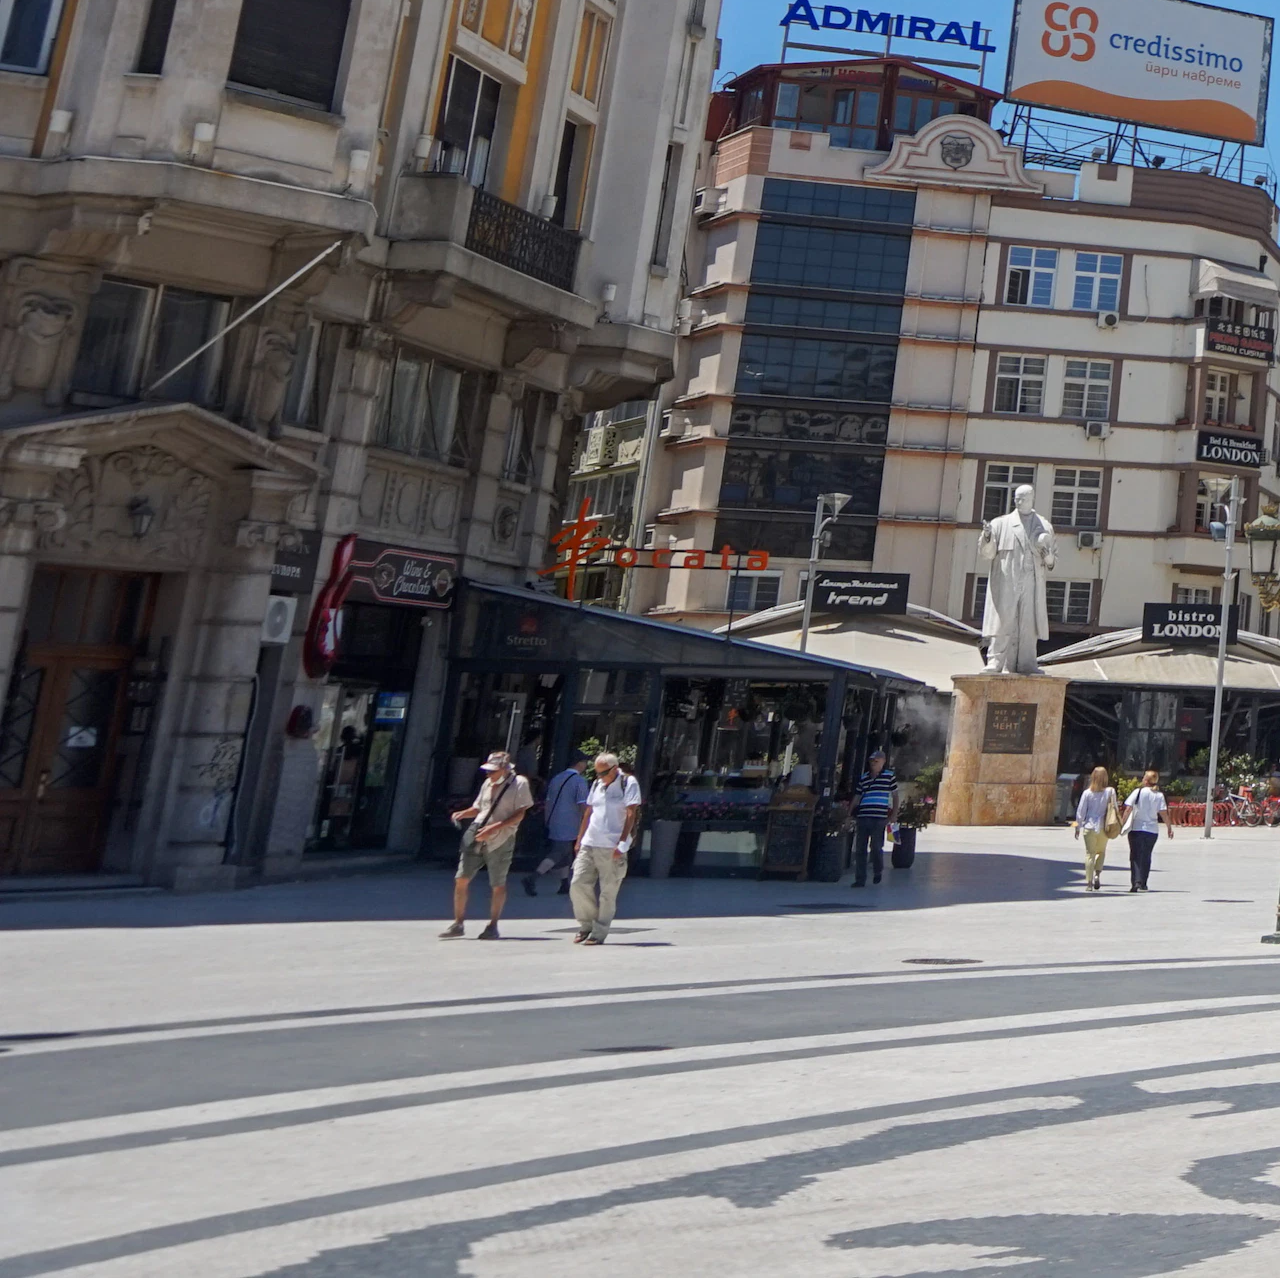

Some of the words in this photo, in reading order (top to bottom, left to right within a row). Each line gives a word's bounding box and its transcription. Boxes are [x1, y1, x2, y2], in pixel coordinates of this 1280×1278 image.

[1109, 32, 1243, 73] credissimo
[1182, 70, 1242, 89] навреме
[1209, 436, 1221, 445] Bed
[1222, 437, 1228, 447] &
[1229, 439, 1257, 450] Breakfast
[1201, 445, 1260, 464] LONDON
[826, 591, 889, 607] trend
[1168, 609, 1216, 622] bistro
[506, 634, 548, 647] Stretto
